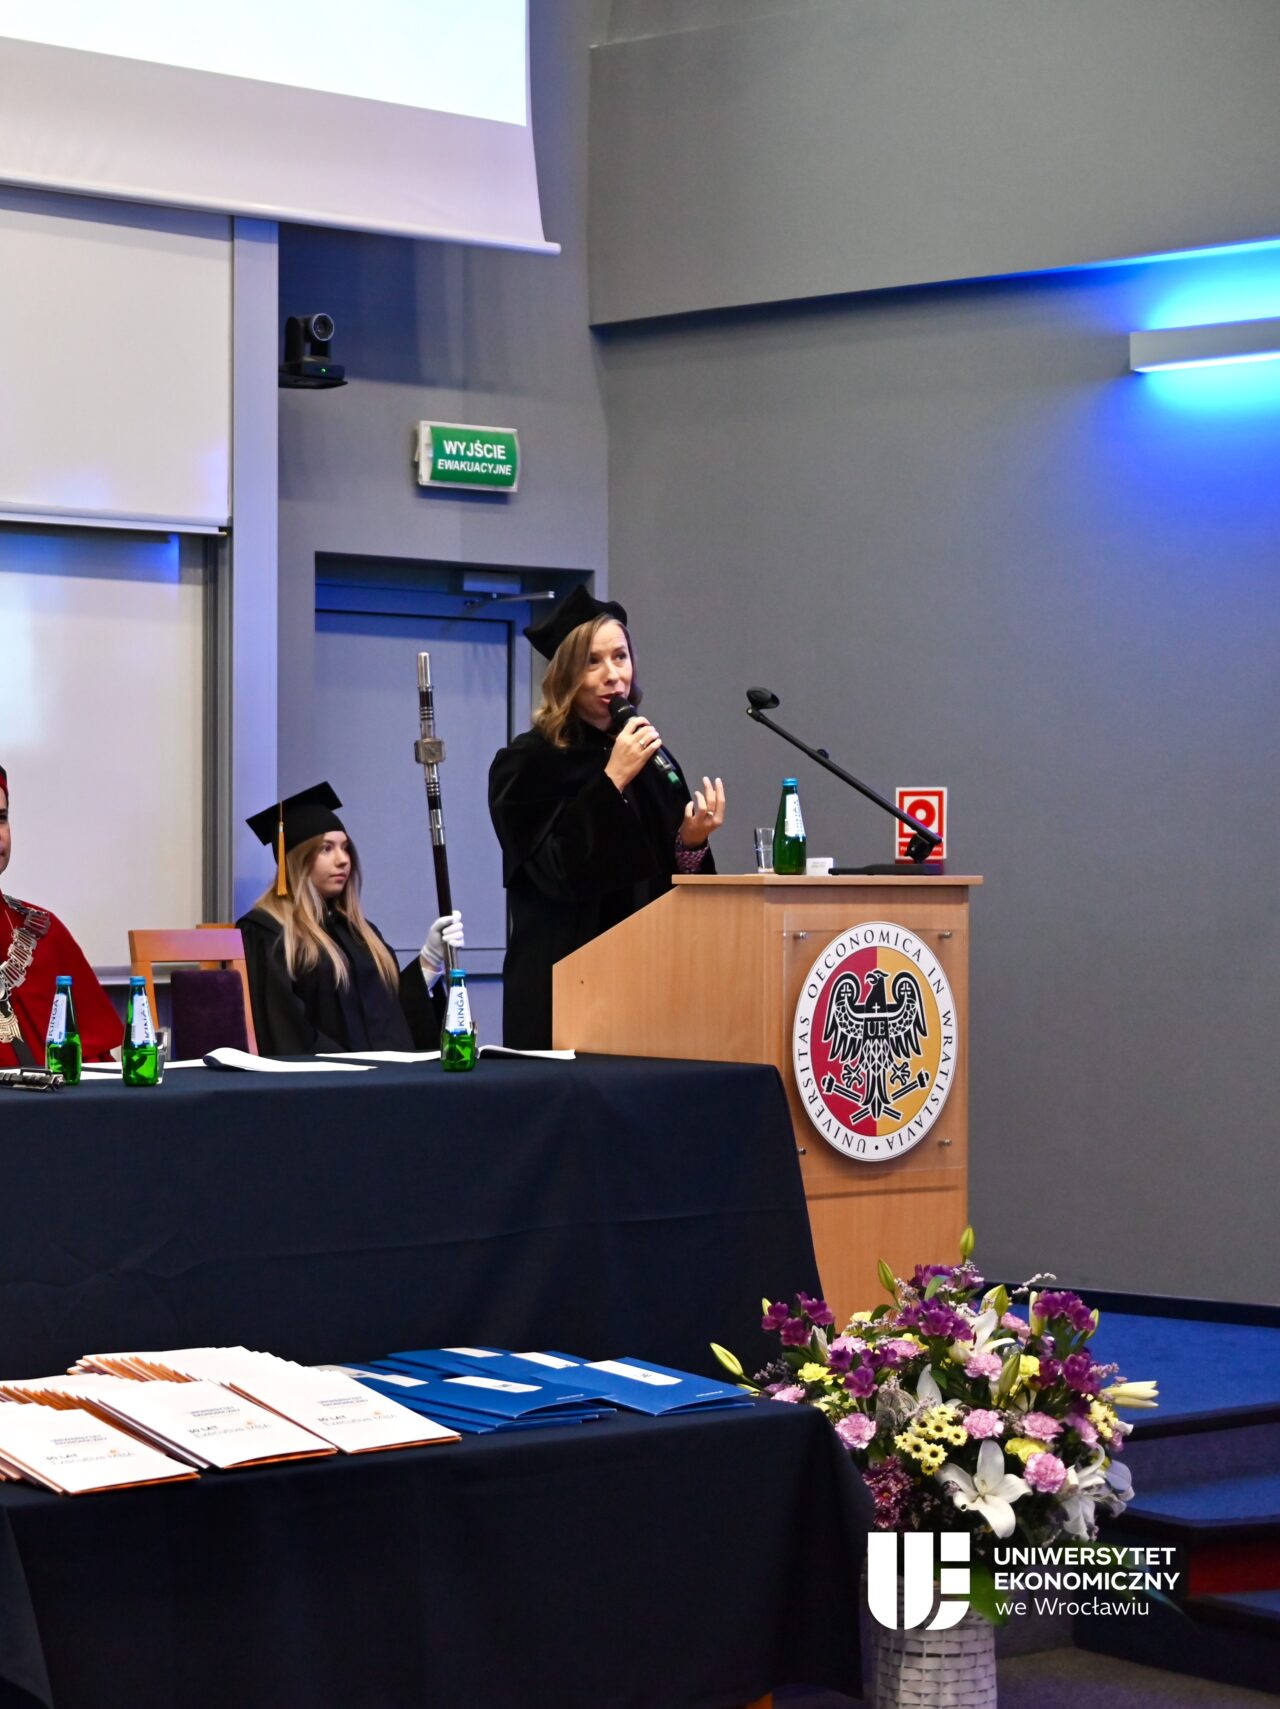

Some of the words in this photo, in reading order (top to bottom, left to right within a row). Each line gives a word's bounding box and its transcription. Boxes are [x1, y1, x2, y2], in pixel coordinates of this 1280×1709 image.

[443, 440, 507, 460] WYJŚCIE
[437, 459, 513, 475] EWAKUACYJNE
[808, 929, 922, 999] OECONOMICA
[927, 967, 945, 995] IN
[457, 992, 465, 1027] KINGA
[867, 1021, 886, 1037] UE
[797, 1015, 867, 1154] UNIVERSITAS
[886, 1010, 953, 1151] WRATISLAVIA
